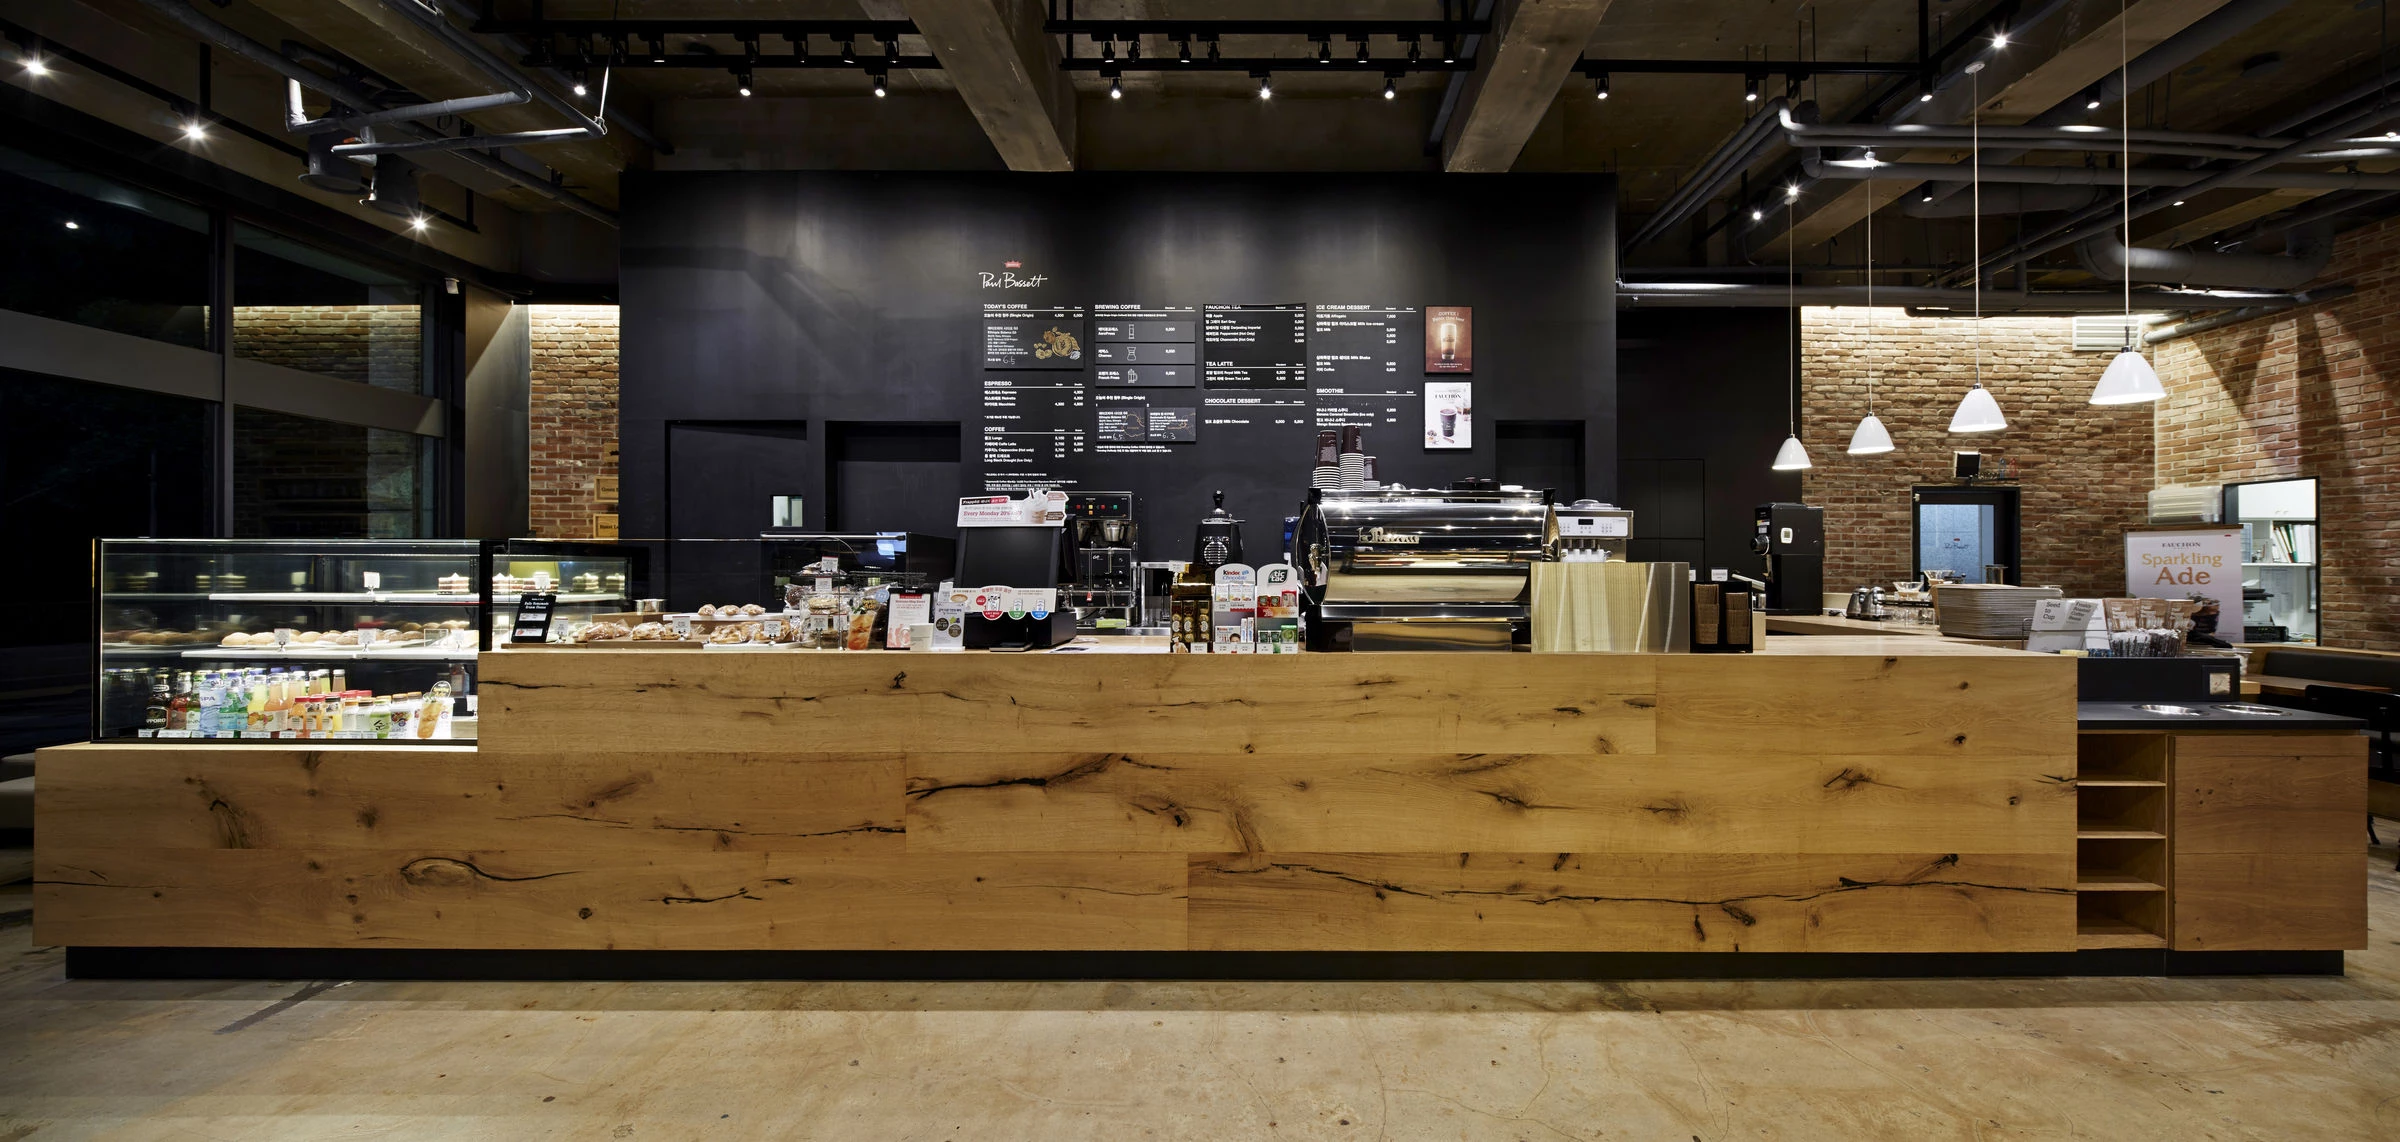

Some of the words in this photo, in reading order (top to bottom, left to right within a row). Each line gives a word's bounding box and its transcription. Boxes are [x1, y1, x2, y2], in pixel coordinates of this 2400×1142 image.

[978, 272, 1001, 288] Paul
[1003, 272, 1048, 288] Bassett
[2142, 552, 2222, 568] Sparkling
[2155, 567, 2211, 585] Ade
